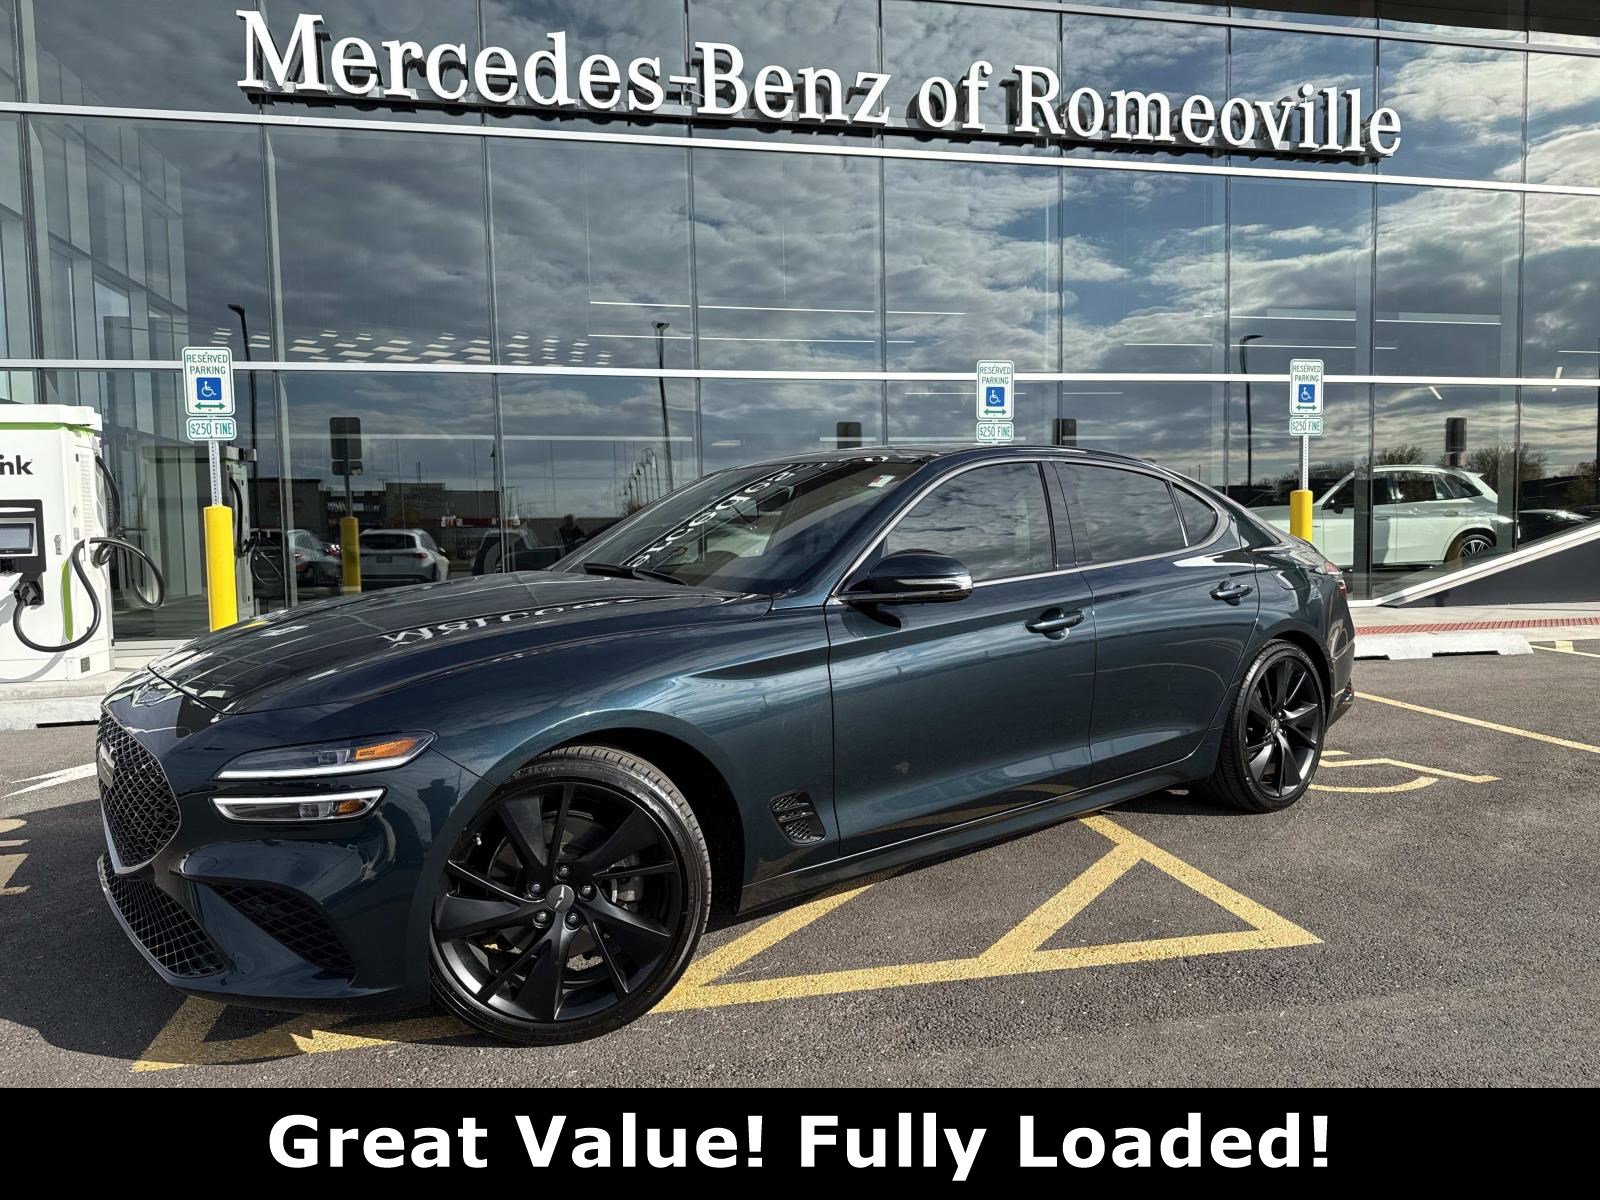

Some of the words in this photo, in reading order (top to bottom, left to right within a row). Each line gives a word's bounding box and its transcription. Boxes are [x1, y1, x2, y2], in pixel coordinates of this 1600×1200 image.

[236, 9, 891, 126] Mercedes-Benz
[919, 60, 993, 131] of
[1014, 64, 1401, 155] Romeoville
[186, 354, 228, 363] RESERVED
[189, 366, 226, 375] PARKING
[980, 366, 1011, 374] RESERVED
[1292, 365, 1321, 373] RESERVED
[981, 376, 1009, 384] PARKING
[1294, 374, 1319, 382] PARKING
[190, 422, 212, 435] $250
[214, 422, 233, 435] FINE
[1292, 420, 1307, 431] $250
[1308, 420, 1320, 431] FINE
[979, 425, 995, 437] $250
[997, 425, 1011, 437] FINE
